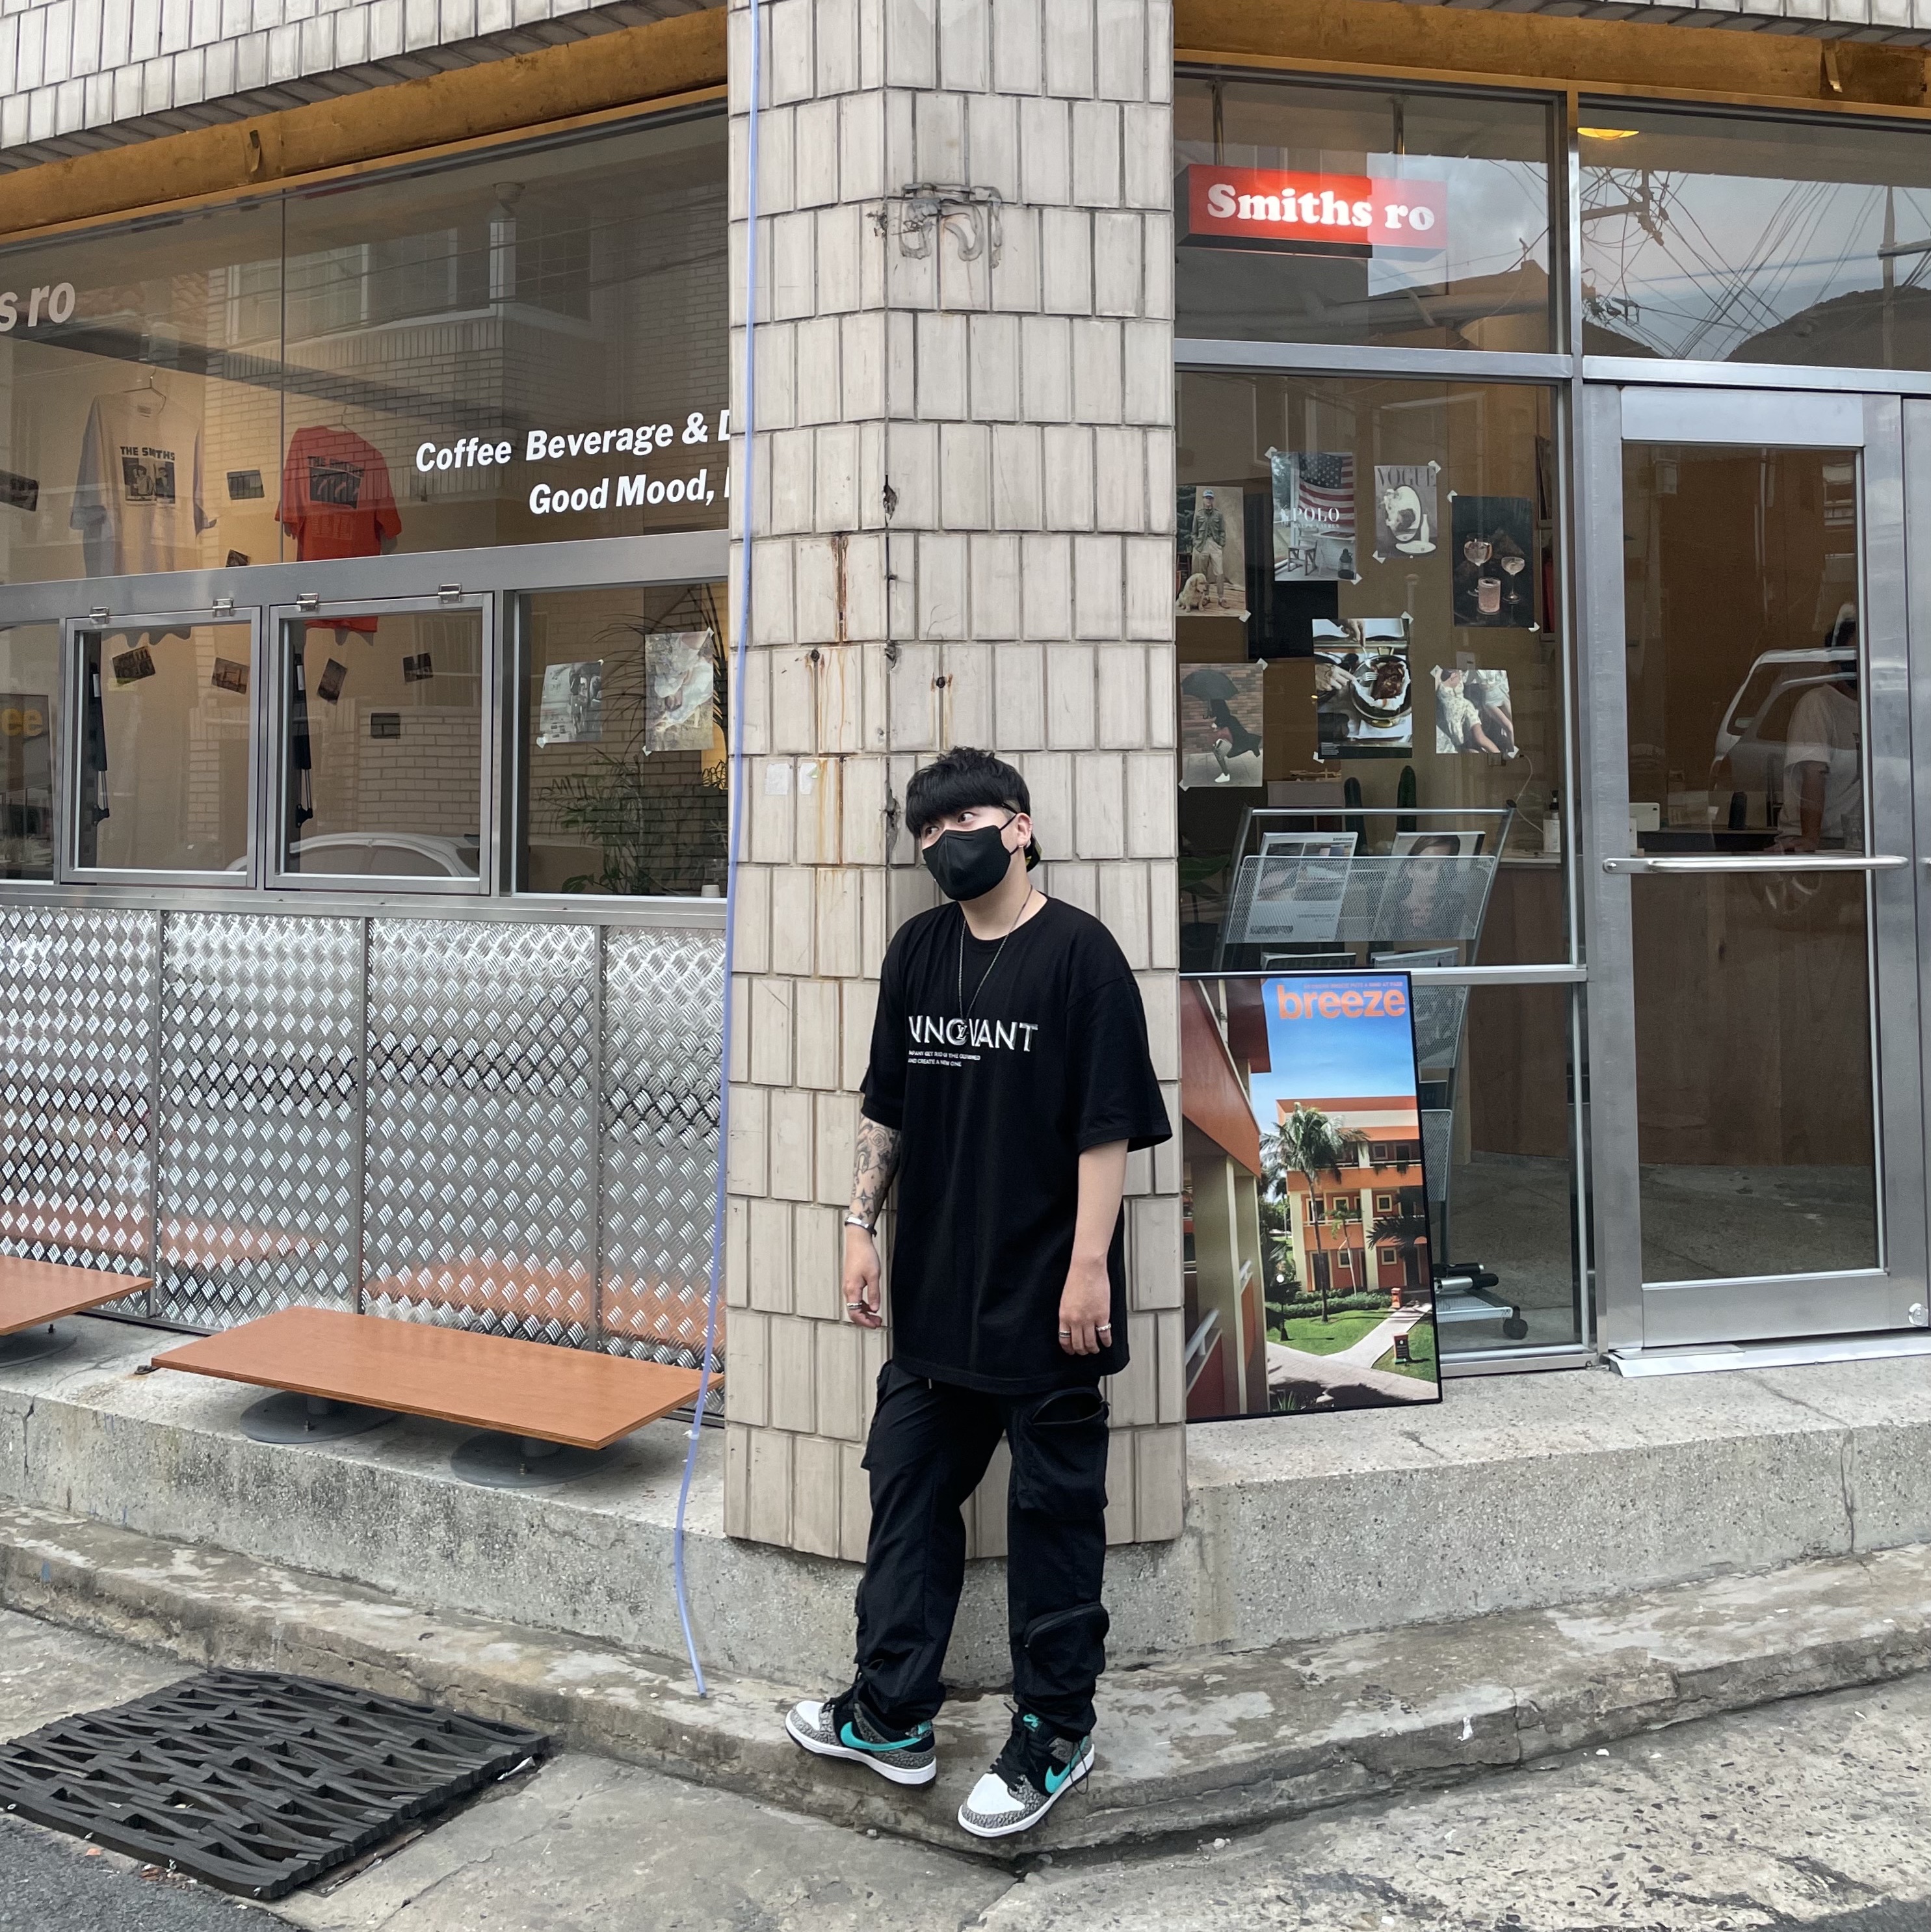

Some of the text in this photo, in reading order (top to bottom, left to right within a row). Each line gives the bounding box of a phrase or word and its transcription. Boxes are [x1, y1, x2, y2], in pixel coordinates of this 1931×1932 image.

[1207, 183, 1435, 231] Smiths ro
[28, 282, 75, 327] ro
[120, 446, 138, 456] THE
[415, 438, 512, 472] Coffee
[526, 423, 674, 460] Beverage
[682, 412, 709, 445] &
[529, 478, 609, 514] Good
[616, 468, 715, 506] Mood,
[1377, 466, 1436, 487] VOGUE
[1293, 508, 1339, 522] POLO
[1277, 984, 1406, 1019] breeze
